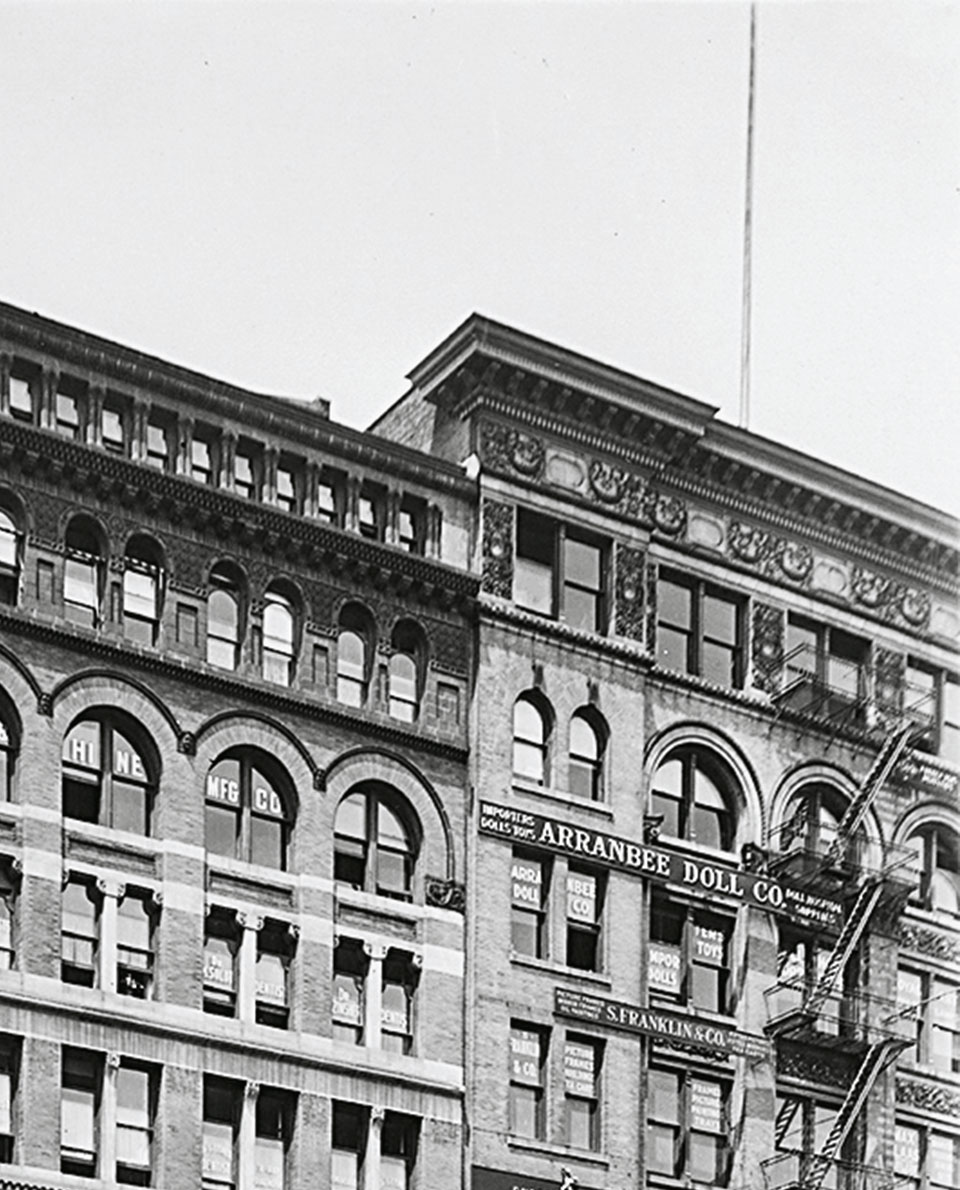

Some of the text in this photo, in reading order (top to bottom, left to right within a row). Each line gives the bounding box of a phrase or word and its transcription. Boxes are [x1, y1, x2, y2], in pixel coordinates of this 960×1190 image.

[207, 775, 239, 802] MFG
[539, 821, 787, 908] ARRANBEE DOLL CO.
